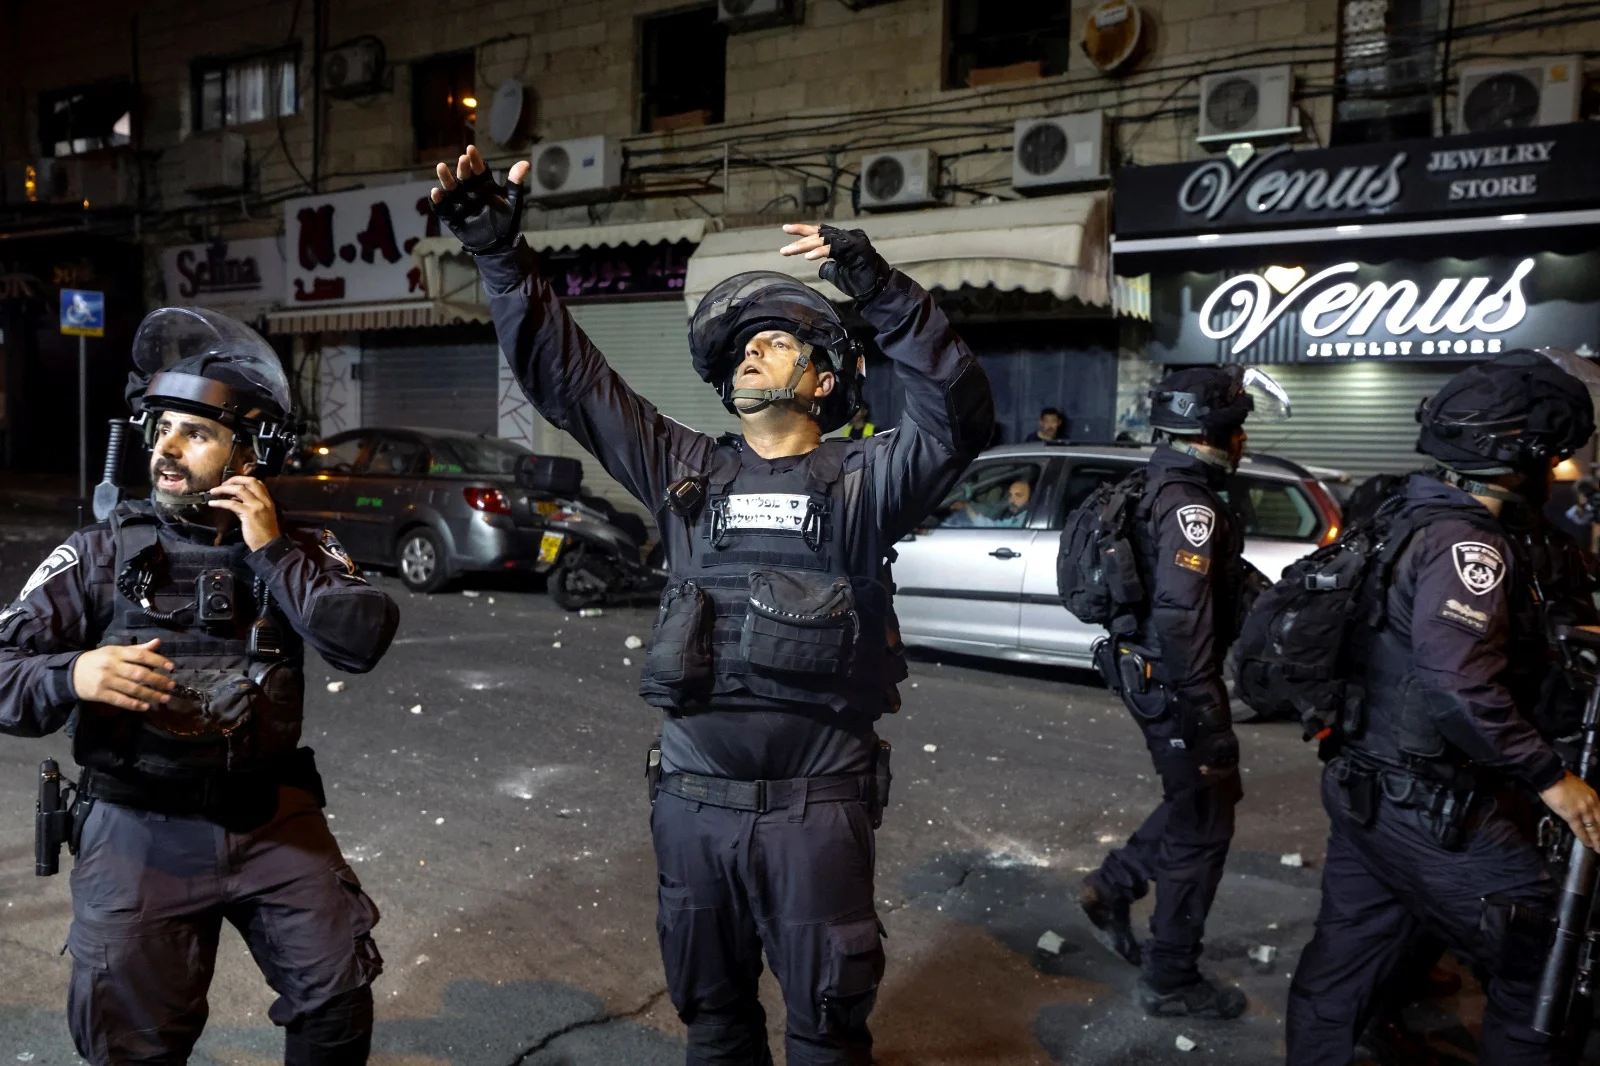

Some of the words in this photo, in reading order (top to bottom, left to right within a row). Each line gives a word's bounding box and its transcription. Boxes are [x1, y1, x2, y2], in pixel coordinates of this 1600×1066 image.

[1426, 140, 1556, 172] JEWELRY
[1178, 143, 1408, 221] Venus
[1449, 174, 1537, 201] STORE
[1198, 257, 1535, 355] Venus
[1306, 341, 1413, 358] JEWELRY
[1421, 339, 1503, 355] STORE
